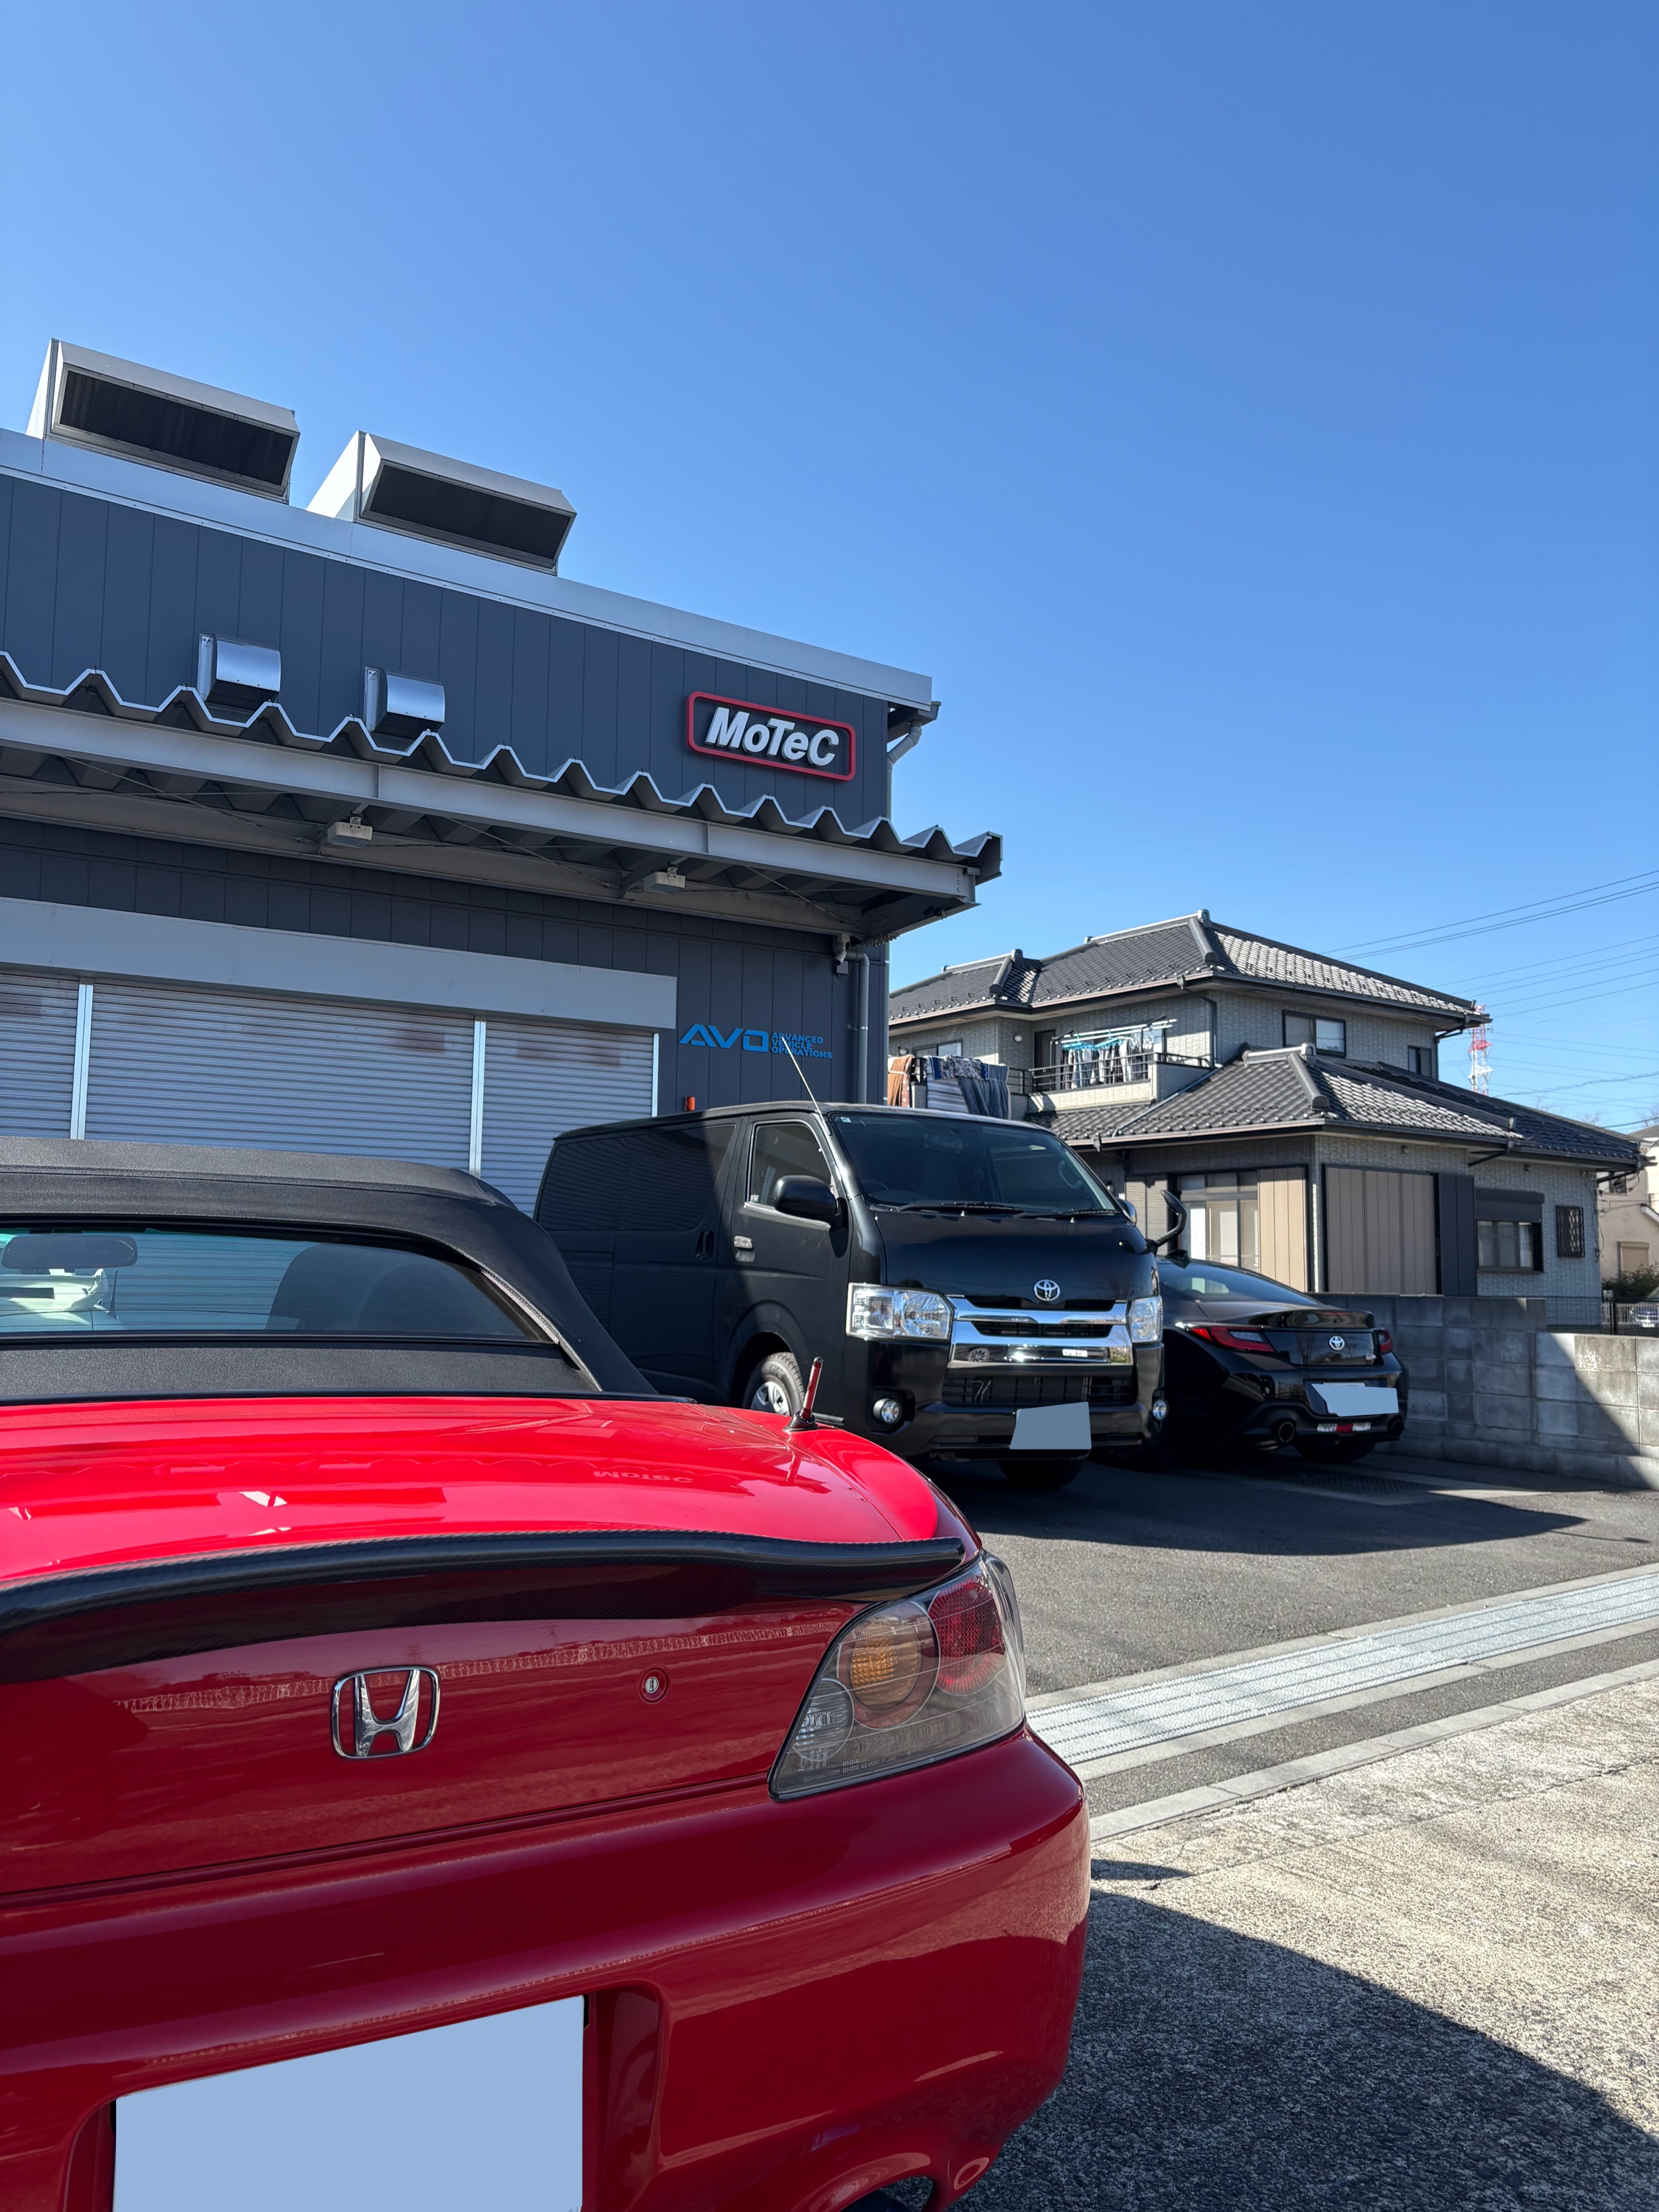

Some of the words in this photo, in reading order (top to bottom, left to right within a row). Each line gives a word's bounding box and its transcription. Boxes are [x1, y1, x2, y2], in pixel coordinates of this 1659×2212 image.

[705, 707, 839, 767] MoTeC
[679, 1023, 768, 1053] AVO
[771, 1032, 824, 1044] ADVANCED
